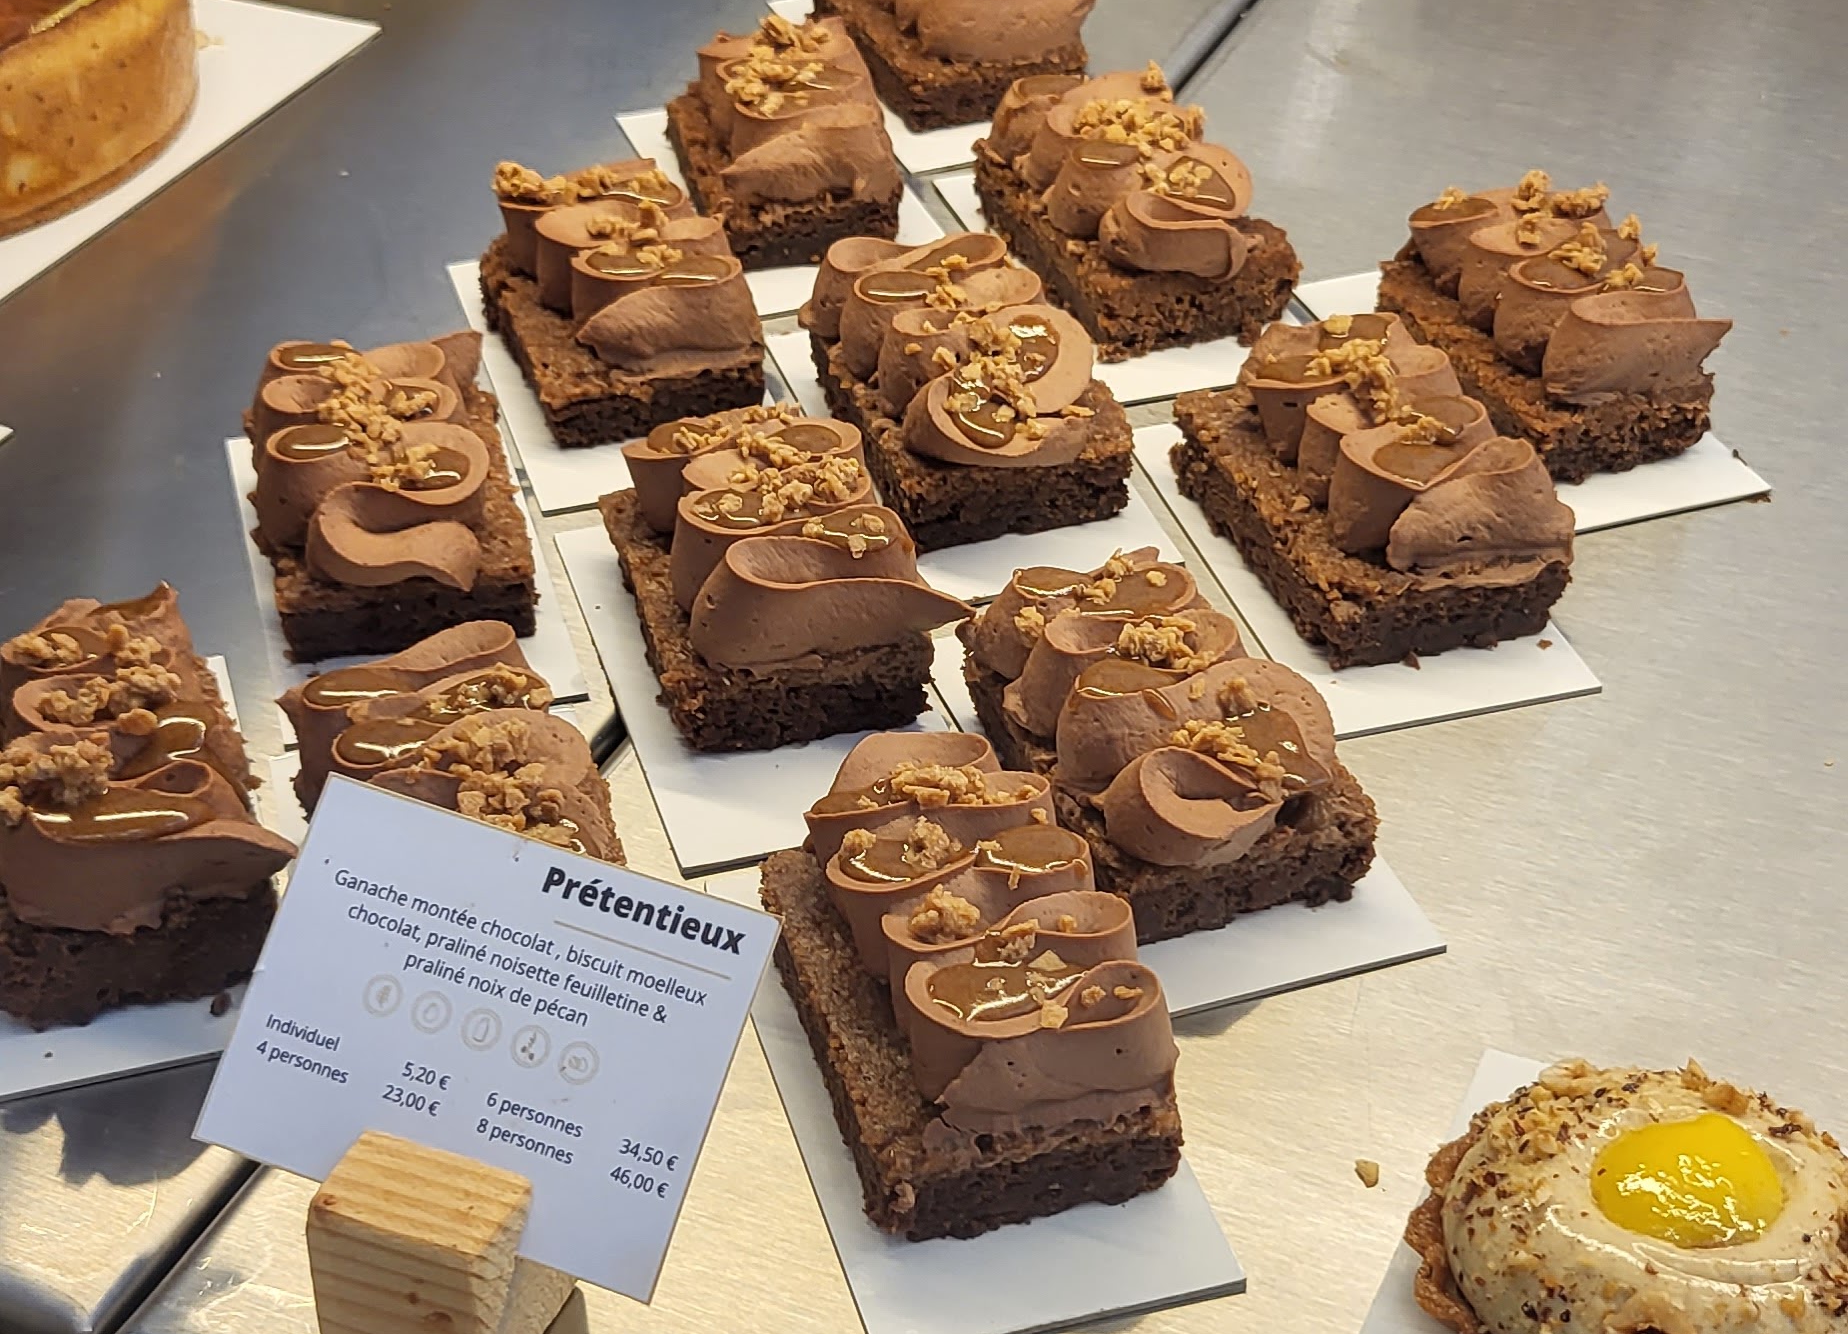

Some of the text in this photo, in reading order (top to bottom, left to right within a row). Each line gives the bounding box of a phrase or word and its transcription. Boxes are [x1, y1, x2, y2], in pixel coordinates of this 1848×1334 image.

[334, 869, 408, 906] Ganache
[411, 897, 478, 930] montée
[566, 945, 624, 979] biscuit
[626, 968, 708, 1007] moelleux
[541, 866, 746, 955] Prétentieux
[348, 904, 668, 1024] chocolat, praliné noisette feuilletine &
[403, 953, 589, 1027] praliné noix de pécan
[256, 1040, 269, 1055] 4
[268, 1046, 349, 1084] personnes
[382, 1084, 426, 1111] 23,00
[265, 1014, 341, 1052] Individuel
[402, 1061, 436, 1086] 5,20
[476, 1118, 489, 1134] 8
[489, 1125, 574, 1165] personnes
[610, 1166, 654, 1193] 46,00
[486, 1092, 499, 1107] 6
[498, 1099, 584, 1138] personnes
[618, 1138, 664, 1166] 34,50
